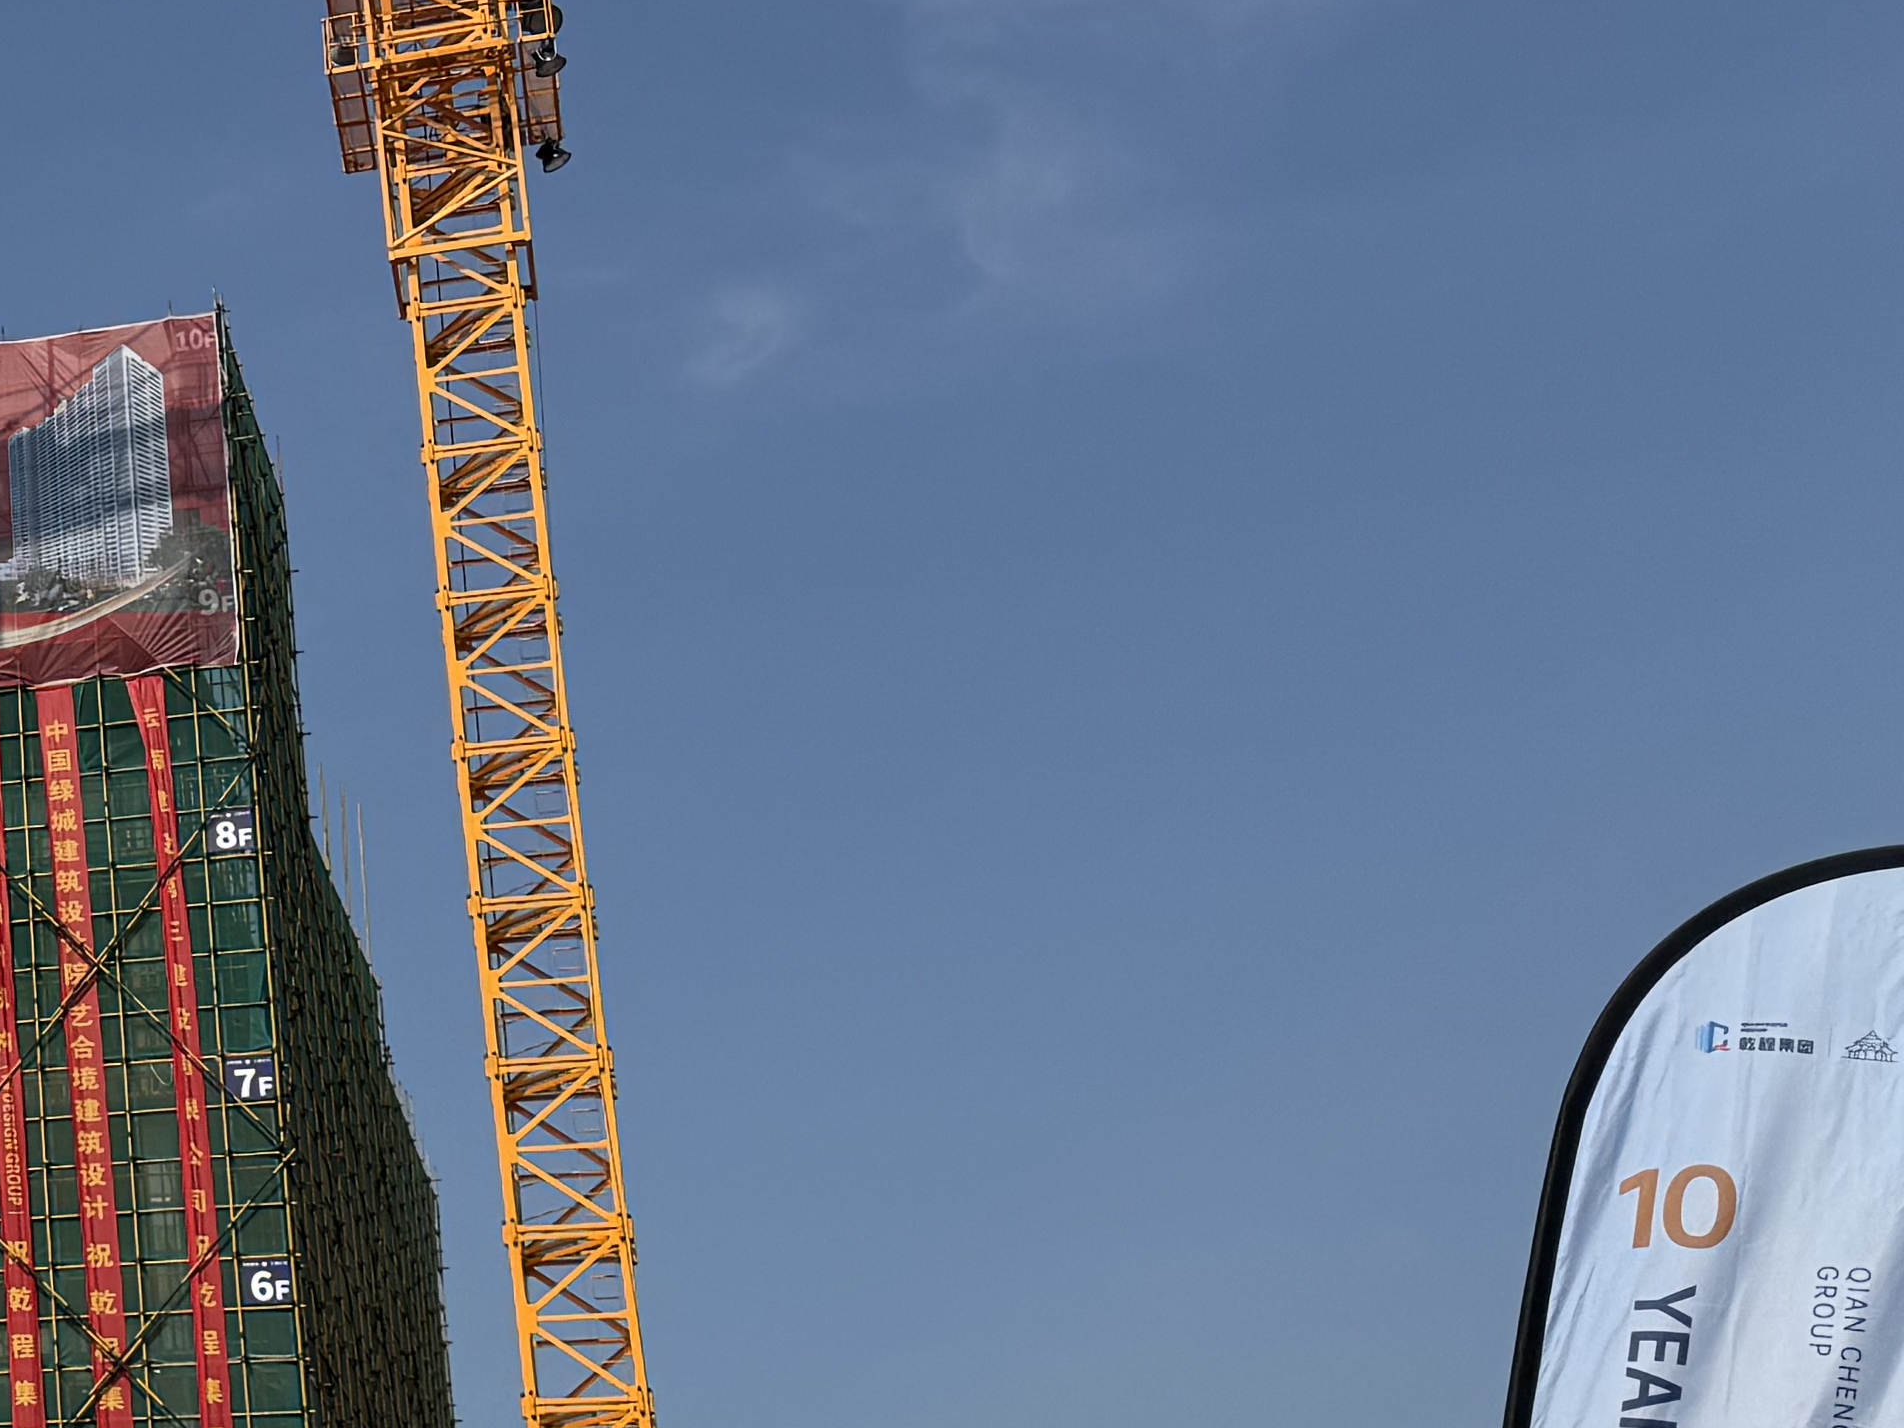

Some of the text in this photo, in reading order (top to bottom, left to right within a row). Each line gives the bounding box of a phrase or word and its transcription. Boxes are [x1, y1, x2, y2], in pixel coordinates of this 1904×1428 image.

[215, 820, 253, 849] 8F
[233, 1068, 273, 1099] 7F
[1619, 1164, 1737, 1250] 10
[250, 1271, 290, 1302] 6F
[1809, 1266, 1839, 1357] GROUP
[1838, 1266, 1872, 1341] QIAN
